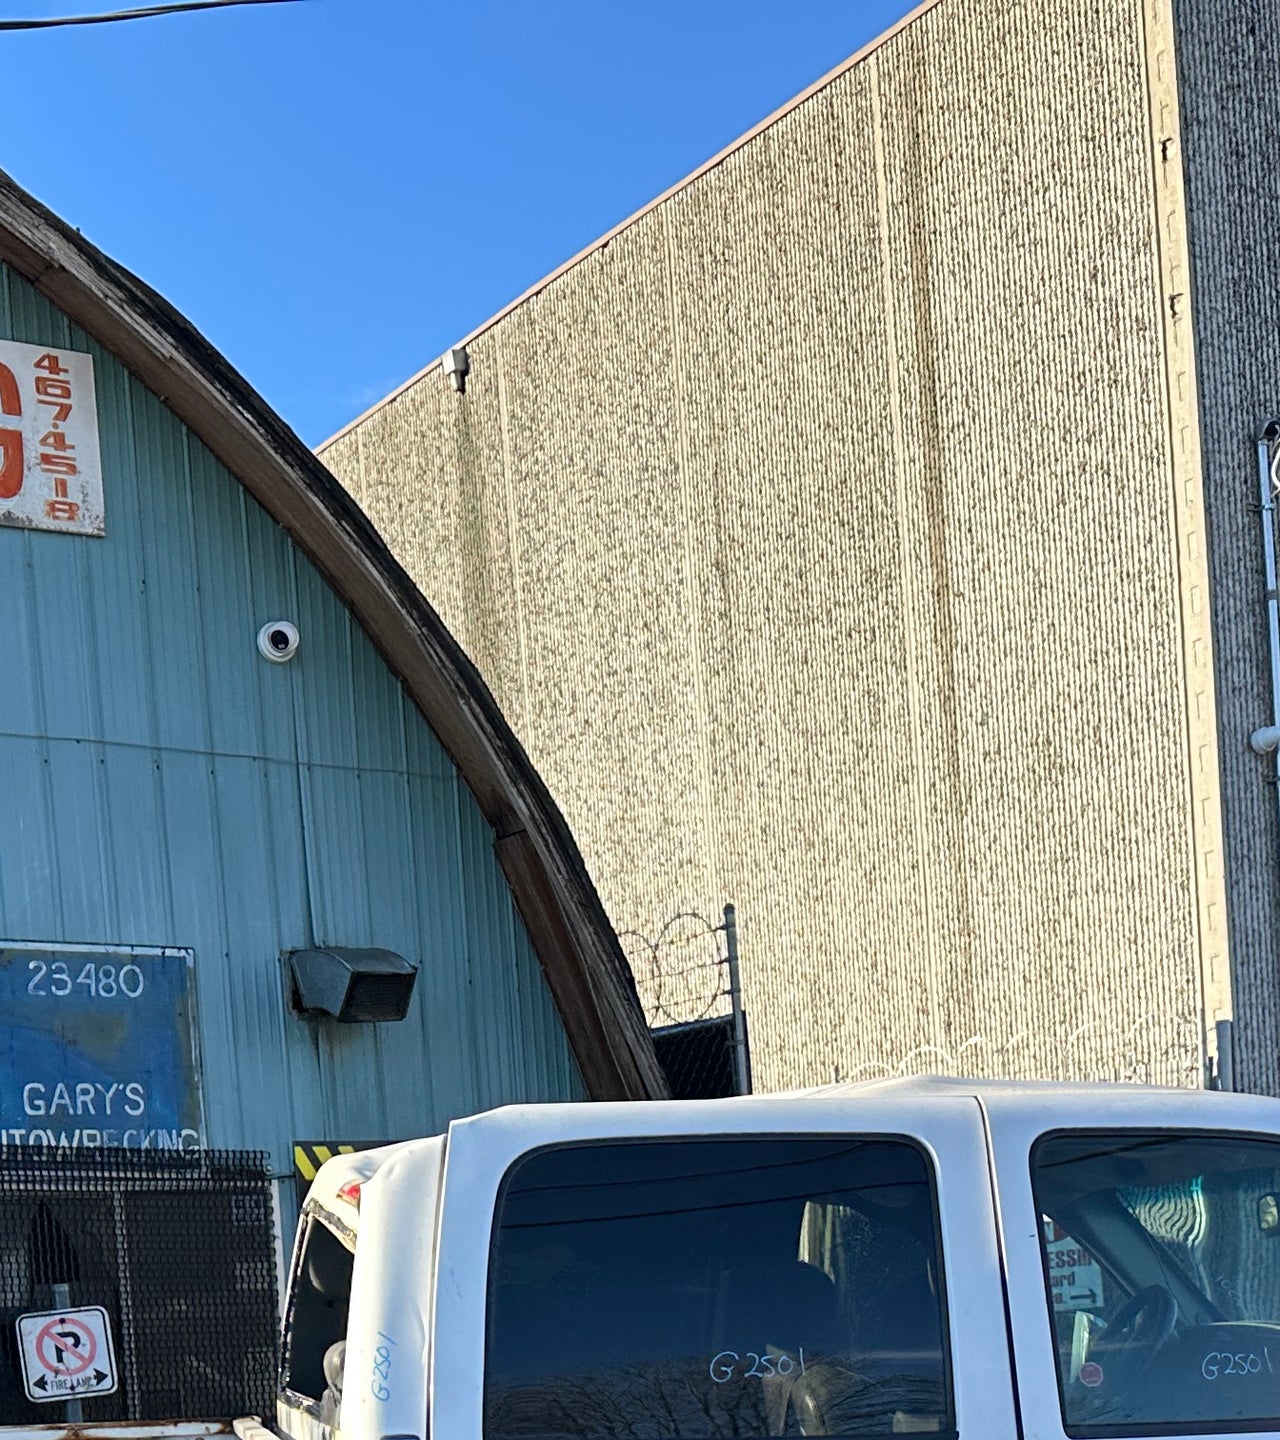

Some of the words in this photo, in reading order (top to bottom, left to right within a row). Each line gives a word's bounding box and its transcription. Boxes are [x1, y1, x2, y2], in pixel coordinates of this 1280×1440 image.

[27, 960, 144, 997] 23480
[23, 1082, 145, 1116] GARY'S
[371, 1331, 397, 1402] G2501
[709, 1347, 806, 1383] G2501
[1201, 1346, 1273, 1380] G2501
[51, 1379, 69, 1391] FIRE
